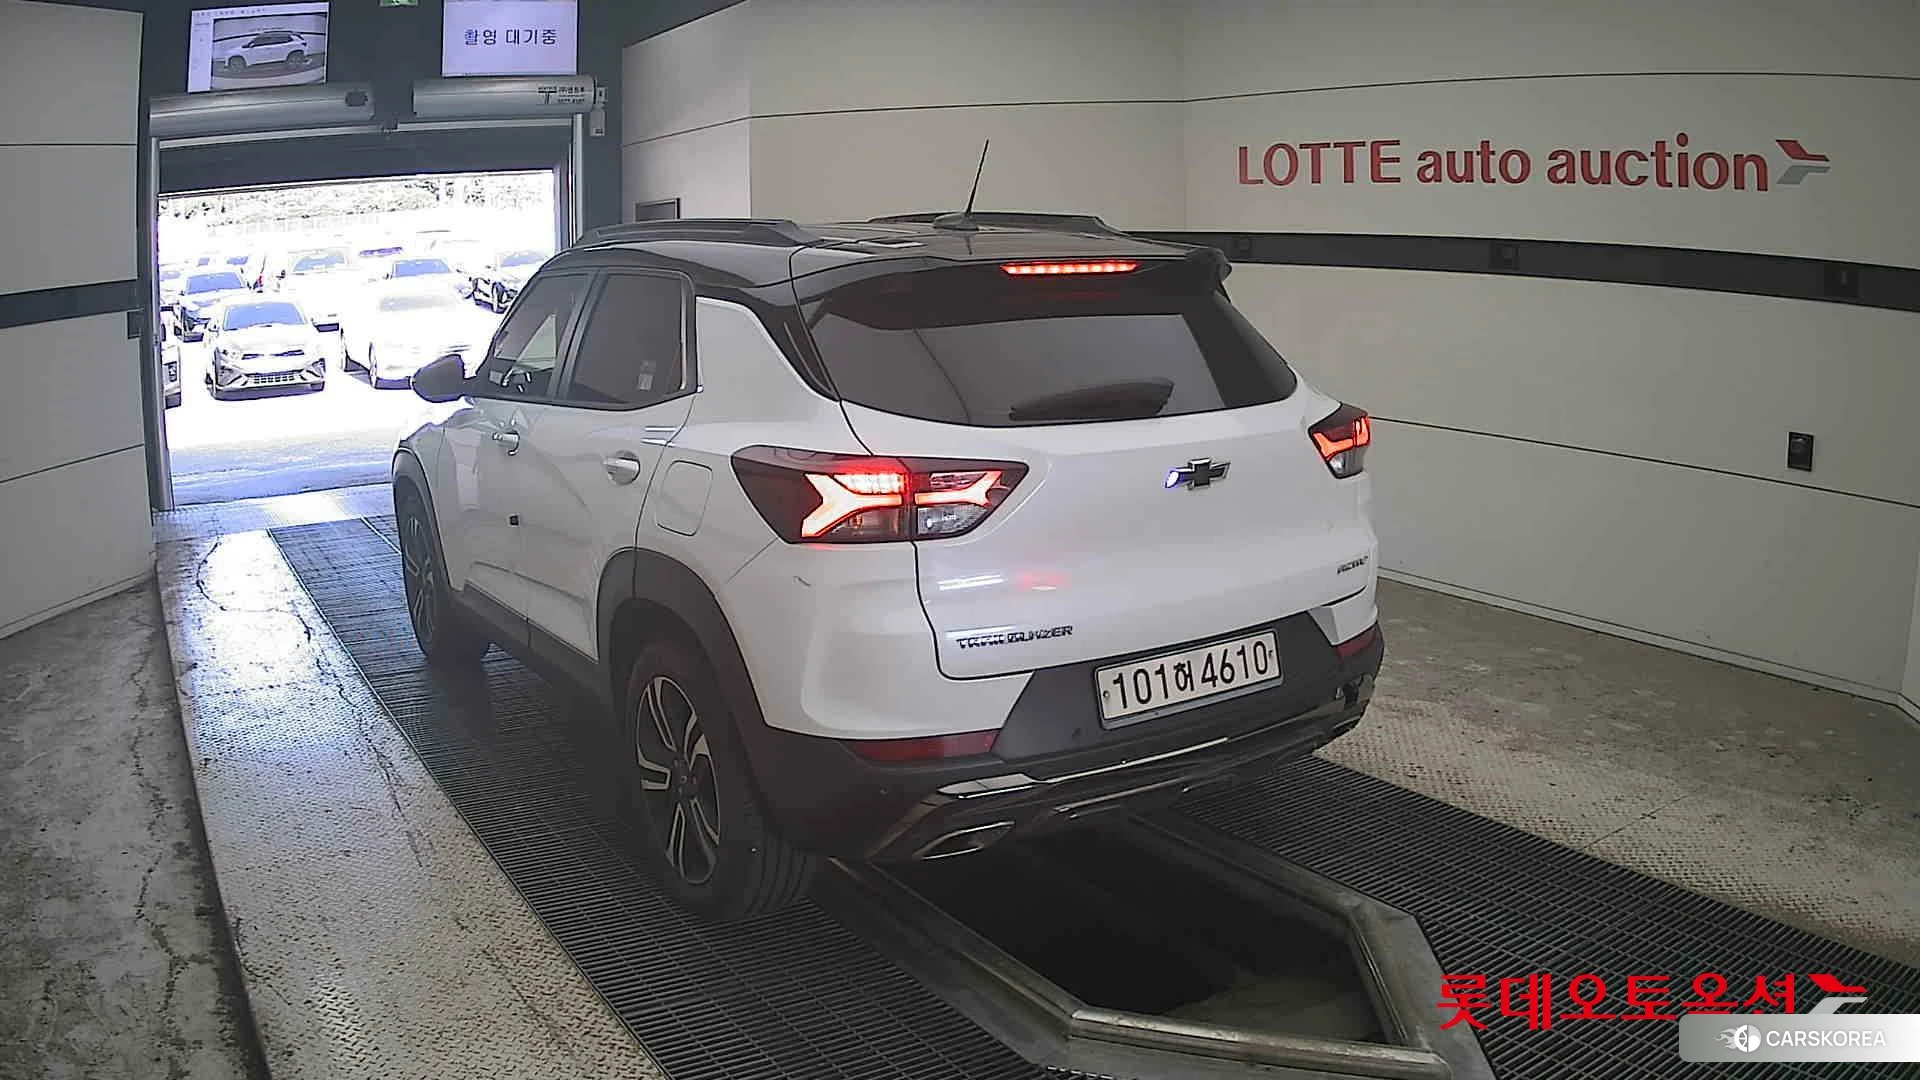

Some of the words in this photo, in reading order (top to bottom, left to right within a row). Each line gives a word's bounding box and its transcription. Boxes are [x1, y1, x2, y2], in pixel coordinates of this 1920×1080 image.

[464, 29, 497, 45] 촬영
[505, 28, 558, 45] 대기중
[1238, 139, 1401, 186] LOTTE
[1416, 139, 1532, 185] auto
[1547, 132, 1769, 192] auction
